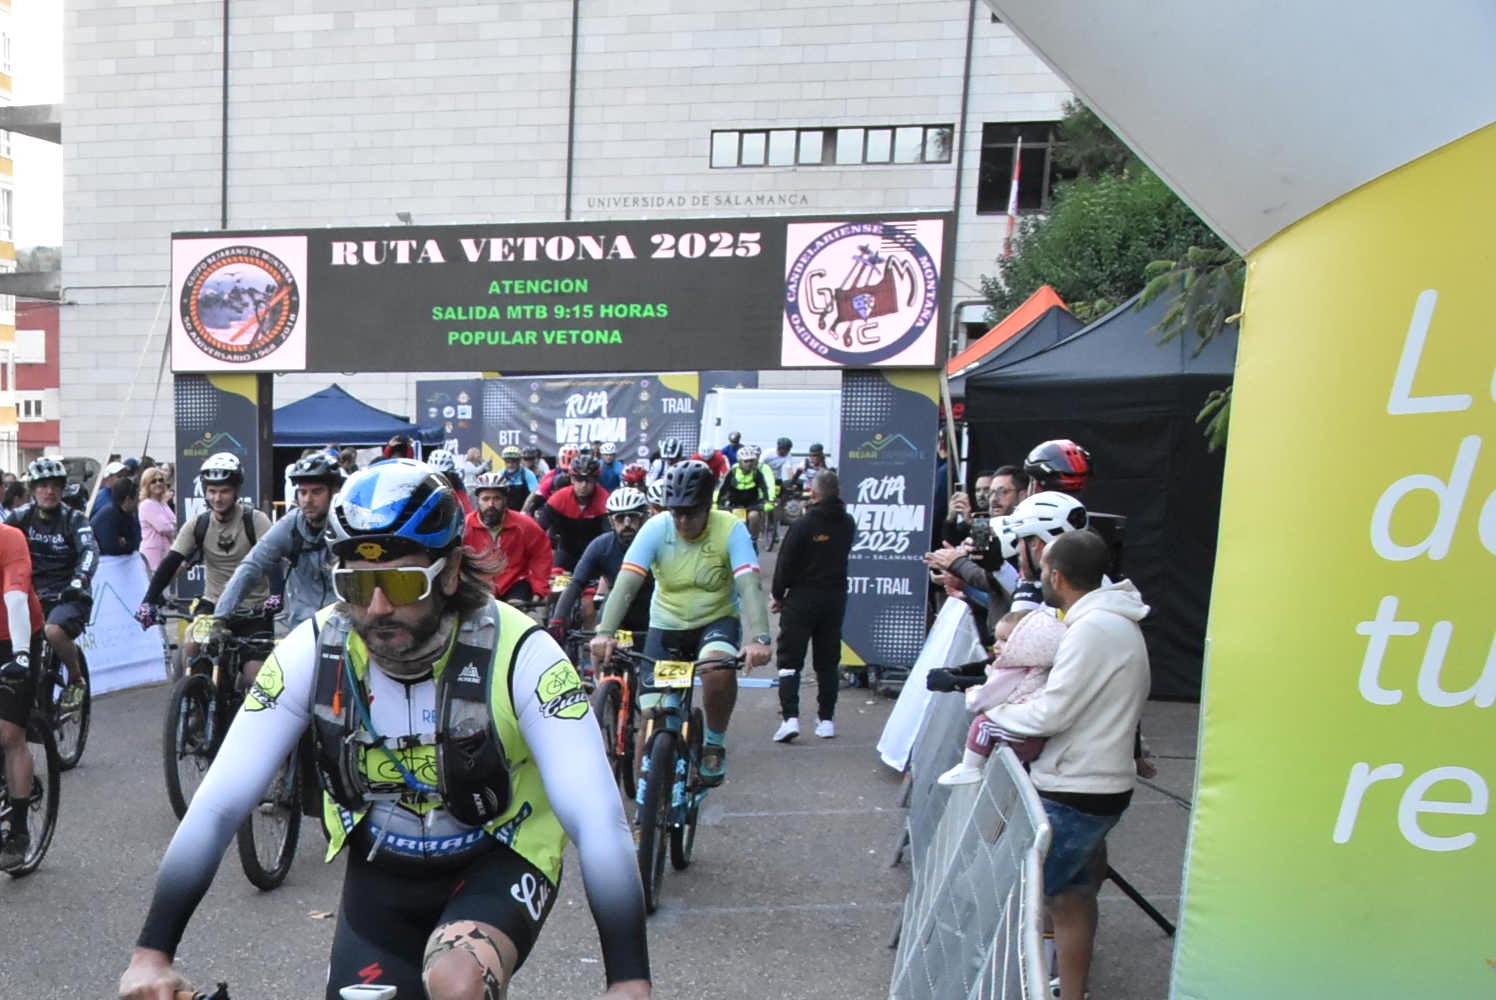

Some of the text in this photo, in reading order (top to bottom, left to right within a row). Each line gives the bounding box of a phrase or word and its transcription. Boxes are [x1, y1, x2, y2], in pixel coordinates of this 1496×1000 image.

[587, 193, 808, 208] UNIVERSIDAD DE SALAMANCA
[205, 247, 249, 269] BEJARANO
[330, 232, 762, 265] RUTA VETONA 2025
[786, 224, 884, 303] CANDELARIENSE
[432, 302, 669, 321] SALIDA MTB 9:15 HORAS
[188, 330, 252, 362] ANIVERSARIO
[448, 329, 623, 346] POPULAR VETONA
[791, 313, 830, 355] GRUPO
[1386, 288, 1496, 415] L
[565, 390, 609, 418] RUTA
[661, 397, 695, 414] TRAIL
[499, 430, 521, 445] BTT
[555, 416, 627, 443] VETONA
[857, 475, 906, 504] RUTA
[1369, 435, 1496, 561] d
[851, 531, 910, 553] 2025
[1356, 595, 1496, 707] tu
[1332, 761, 1489, 851] re
